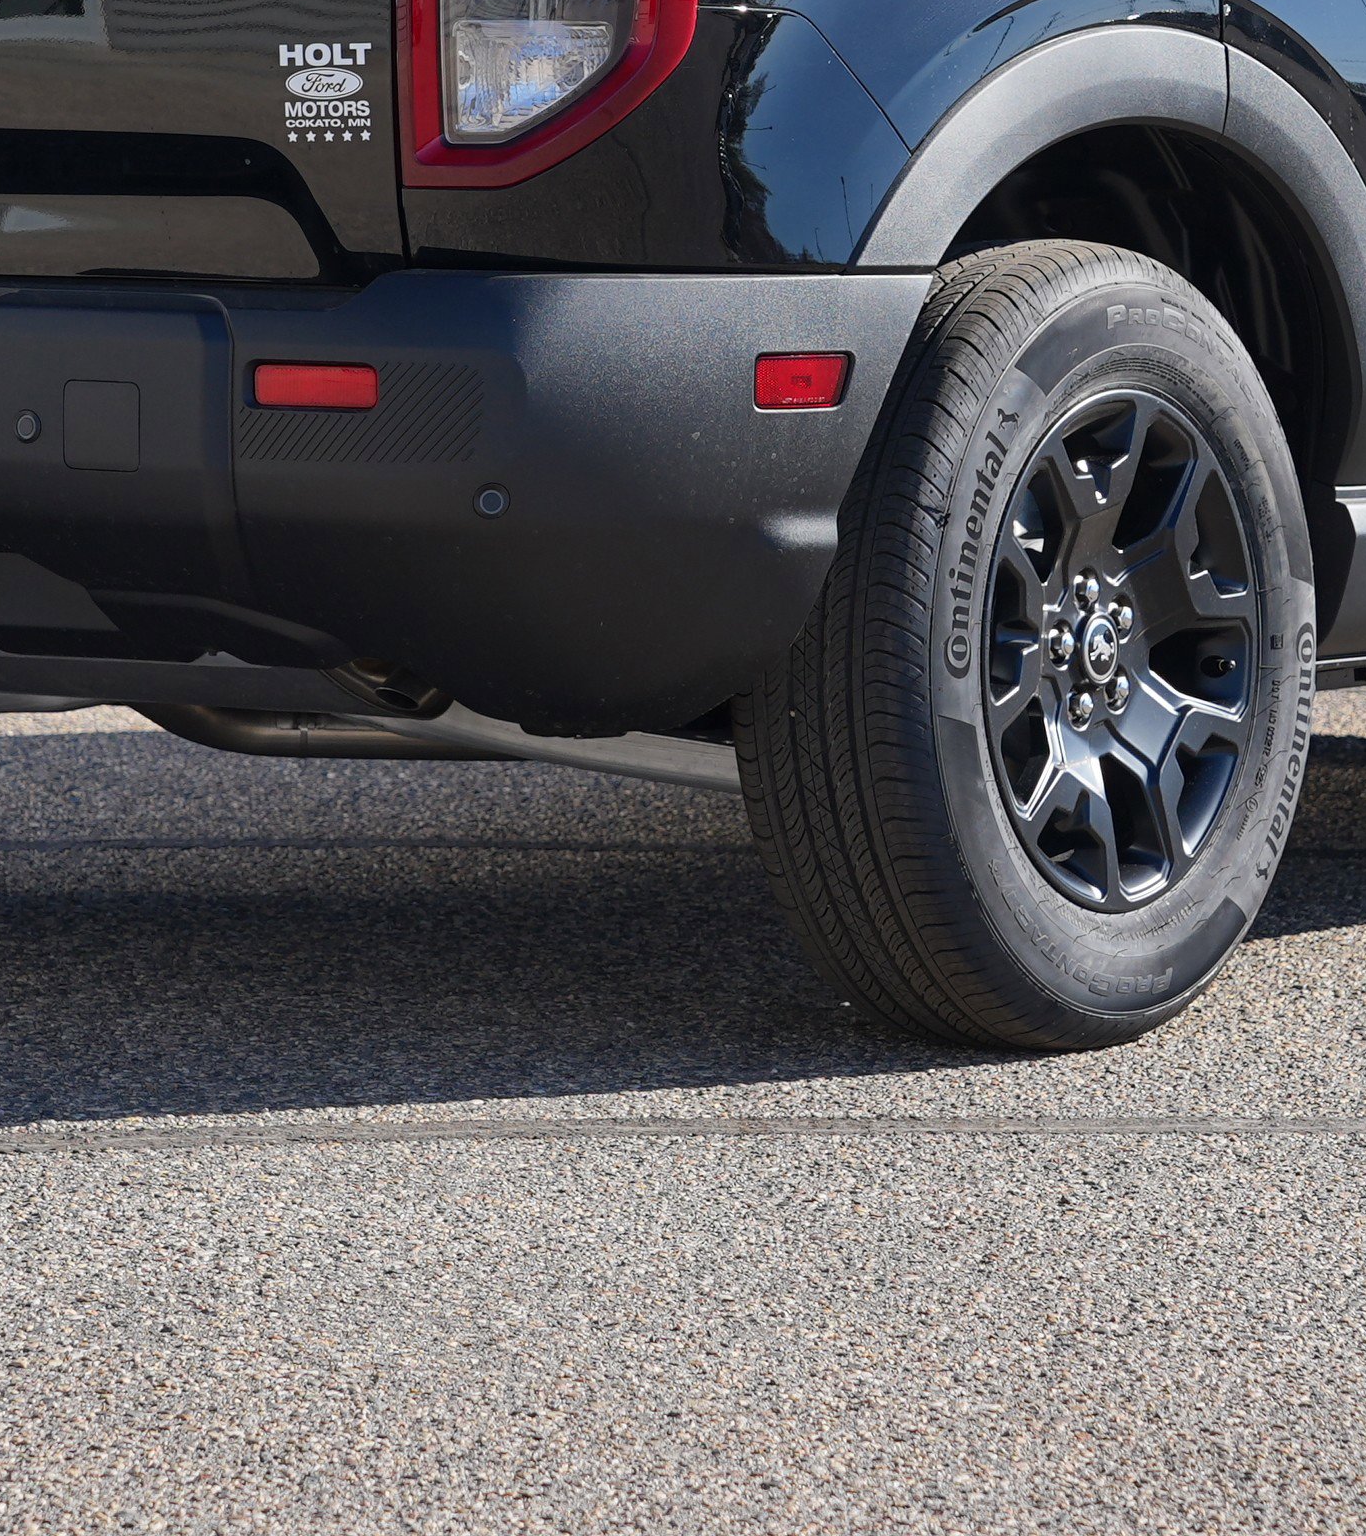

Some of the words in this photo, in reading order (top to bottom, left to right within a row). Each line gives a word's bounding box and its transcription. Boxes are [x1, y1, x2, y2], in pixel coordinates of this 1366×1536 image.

[279, 42, 372, 67] HOLT
[301, 72, 348, 94] Ford
[285, 100, 371, 118] MOTORS
[285, 119, 345, 129] COKATO,
[348, 118, 371, 127] MN
[943, 430, 1011, 680] Continental
[1265, 621, 1316, 858] Continental
